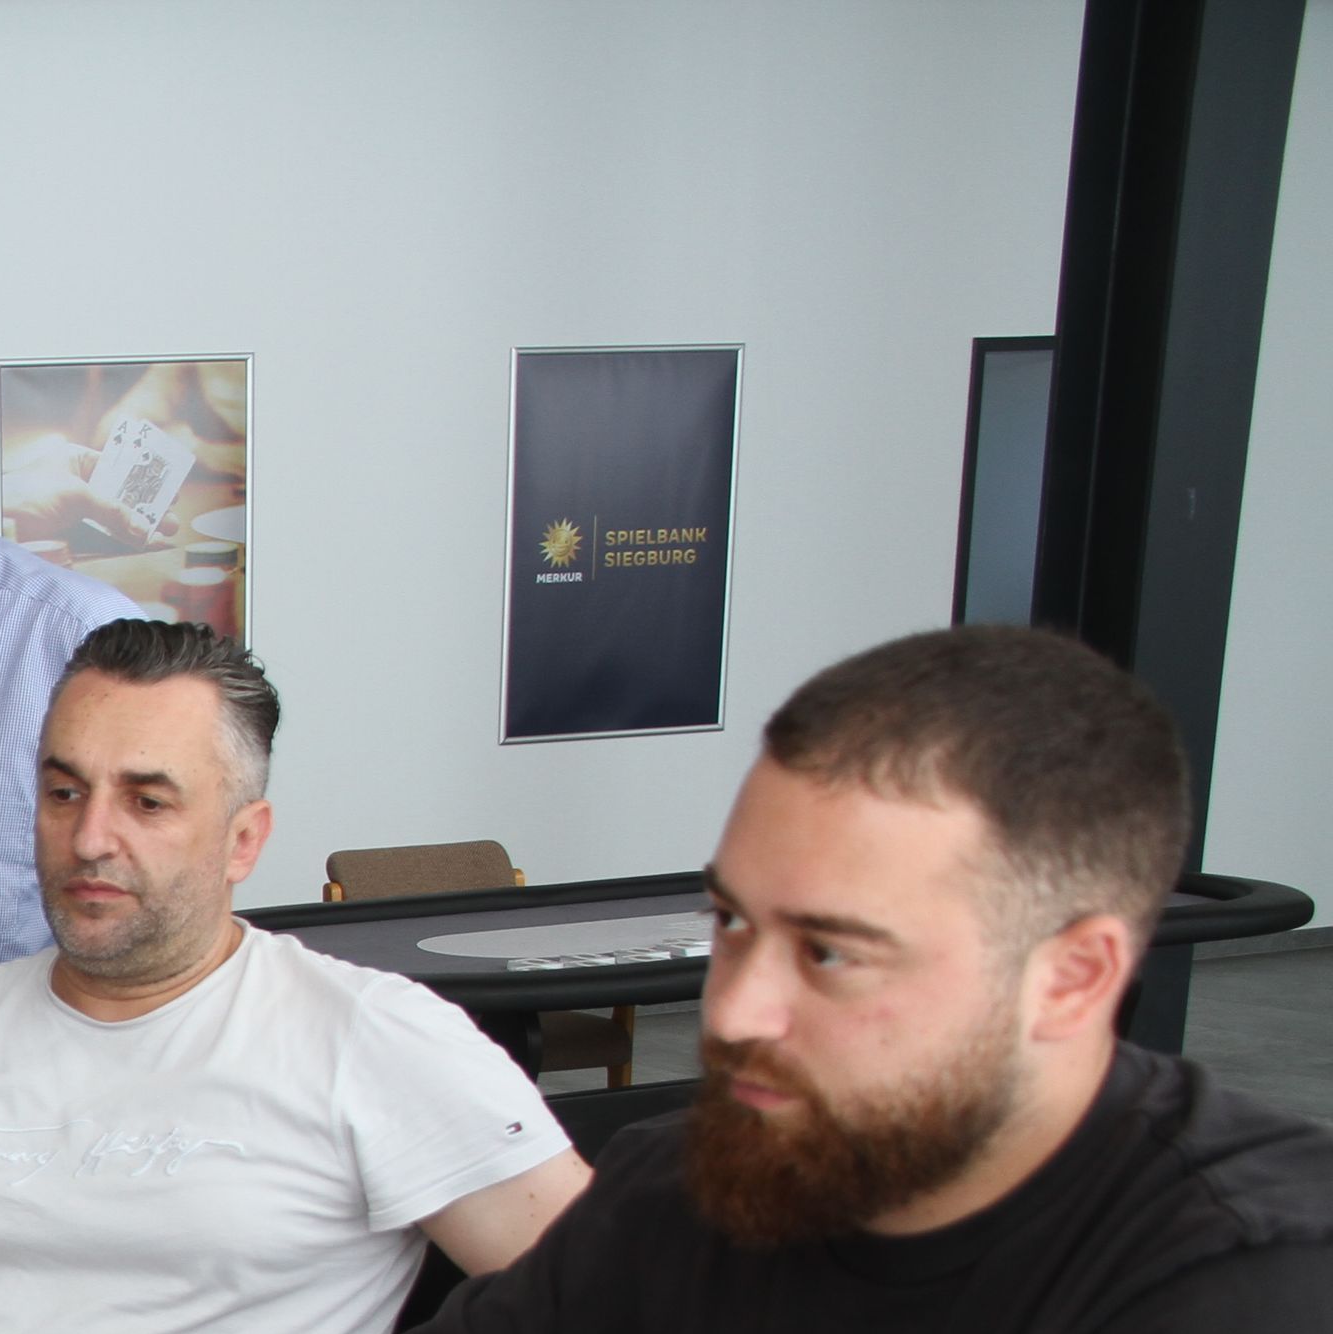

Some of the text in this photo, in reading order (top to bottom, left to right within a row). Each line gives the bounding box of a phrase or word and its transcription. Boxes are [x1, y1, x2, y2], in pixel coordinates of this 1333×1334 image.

[605, 527, 707, 546] SPIELBANK
[604, 548, 697, 568] SIEGBURG
[535, 572, 583, 584] MERKUR
